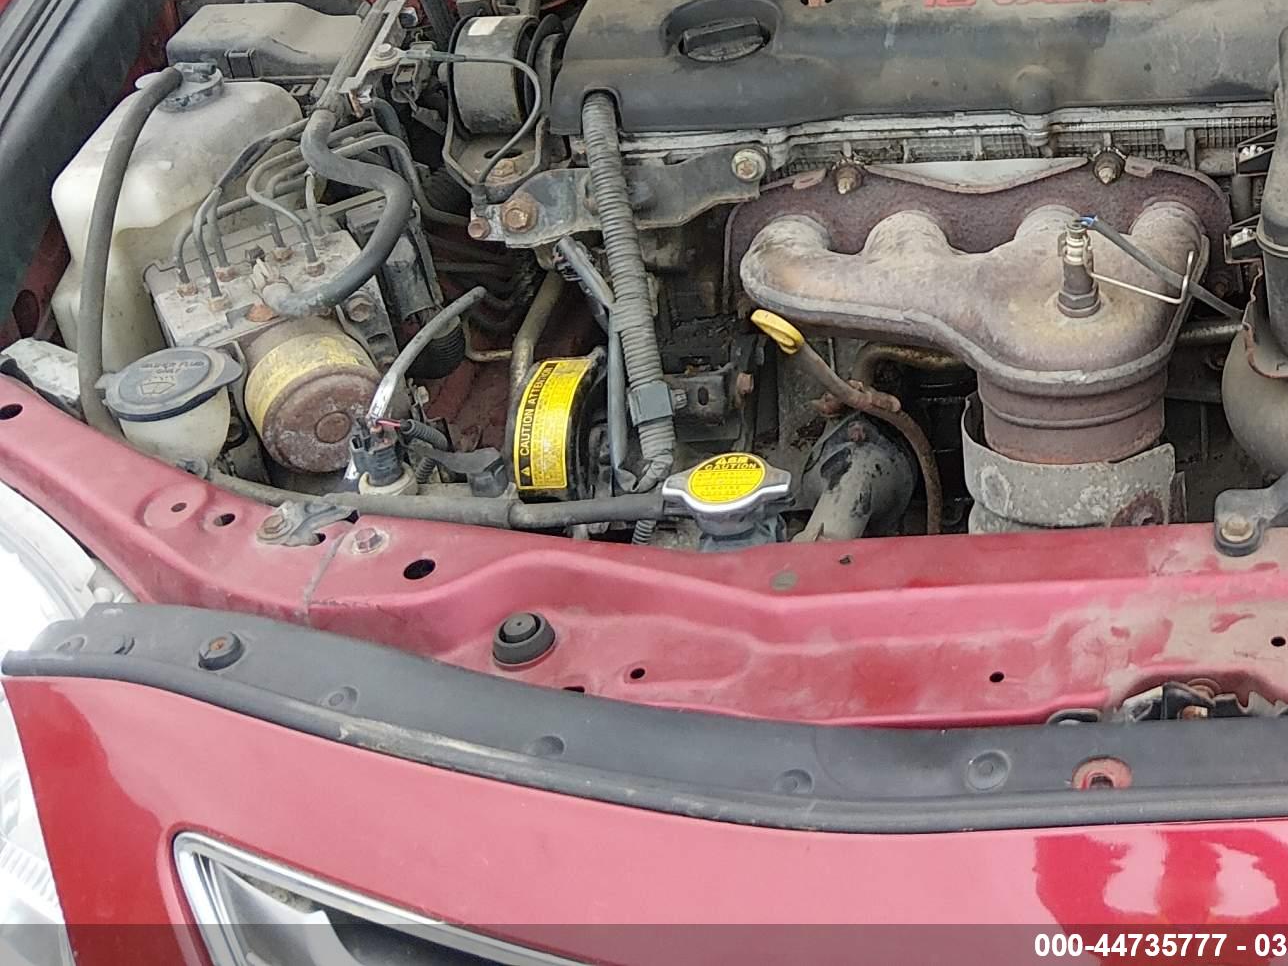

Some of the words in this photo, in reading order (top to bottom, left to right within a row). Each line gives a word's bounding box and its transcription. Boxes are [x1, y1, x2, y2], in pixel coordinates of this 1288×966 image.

[520, 408, 535, 457] CAUTION
[528, 366, 553, 405] ATTENTION
[704, 463, 757, 471] CAUTION
